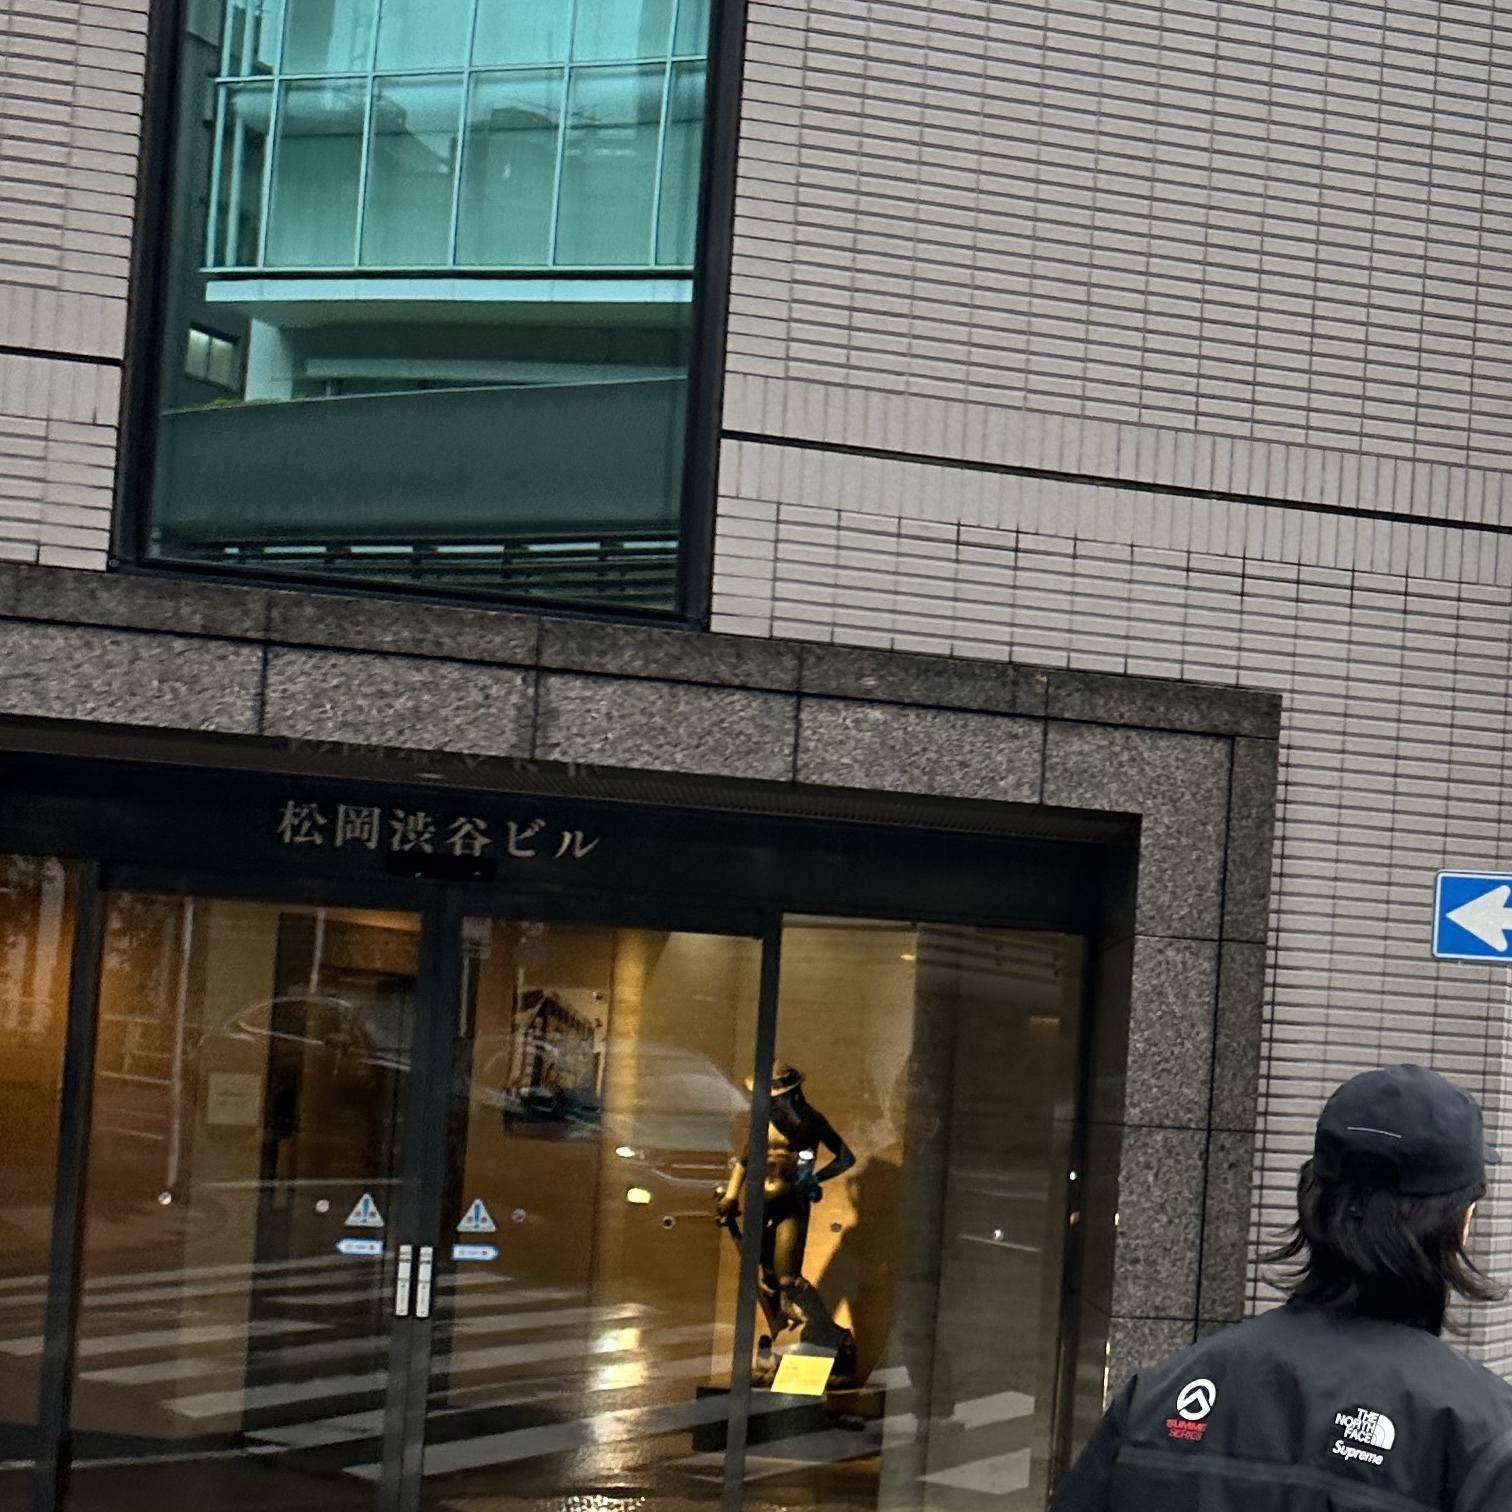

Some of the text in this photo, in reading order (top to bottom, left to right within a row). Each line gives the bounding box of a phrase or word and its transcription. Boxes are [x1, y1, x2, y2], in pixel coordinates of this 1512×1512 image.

[277, 800, 600, 860] 松岡渋谷ビル
[1334, 1412, 1377, 1434] NORTH
[1357, 1407, 1380, 1422] THE
[1344, 1426, 1373, 1444] FACE
[1332, 1440, 1384, 1465] Supreme
